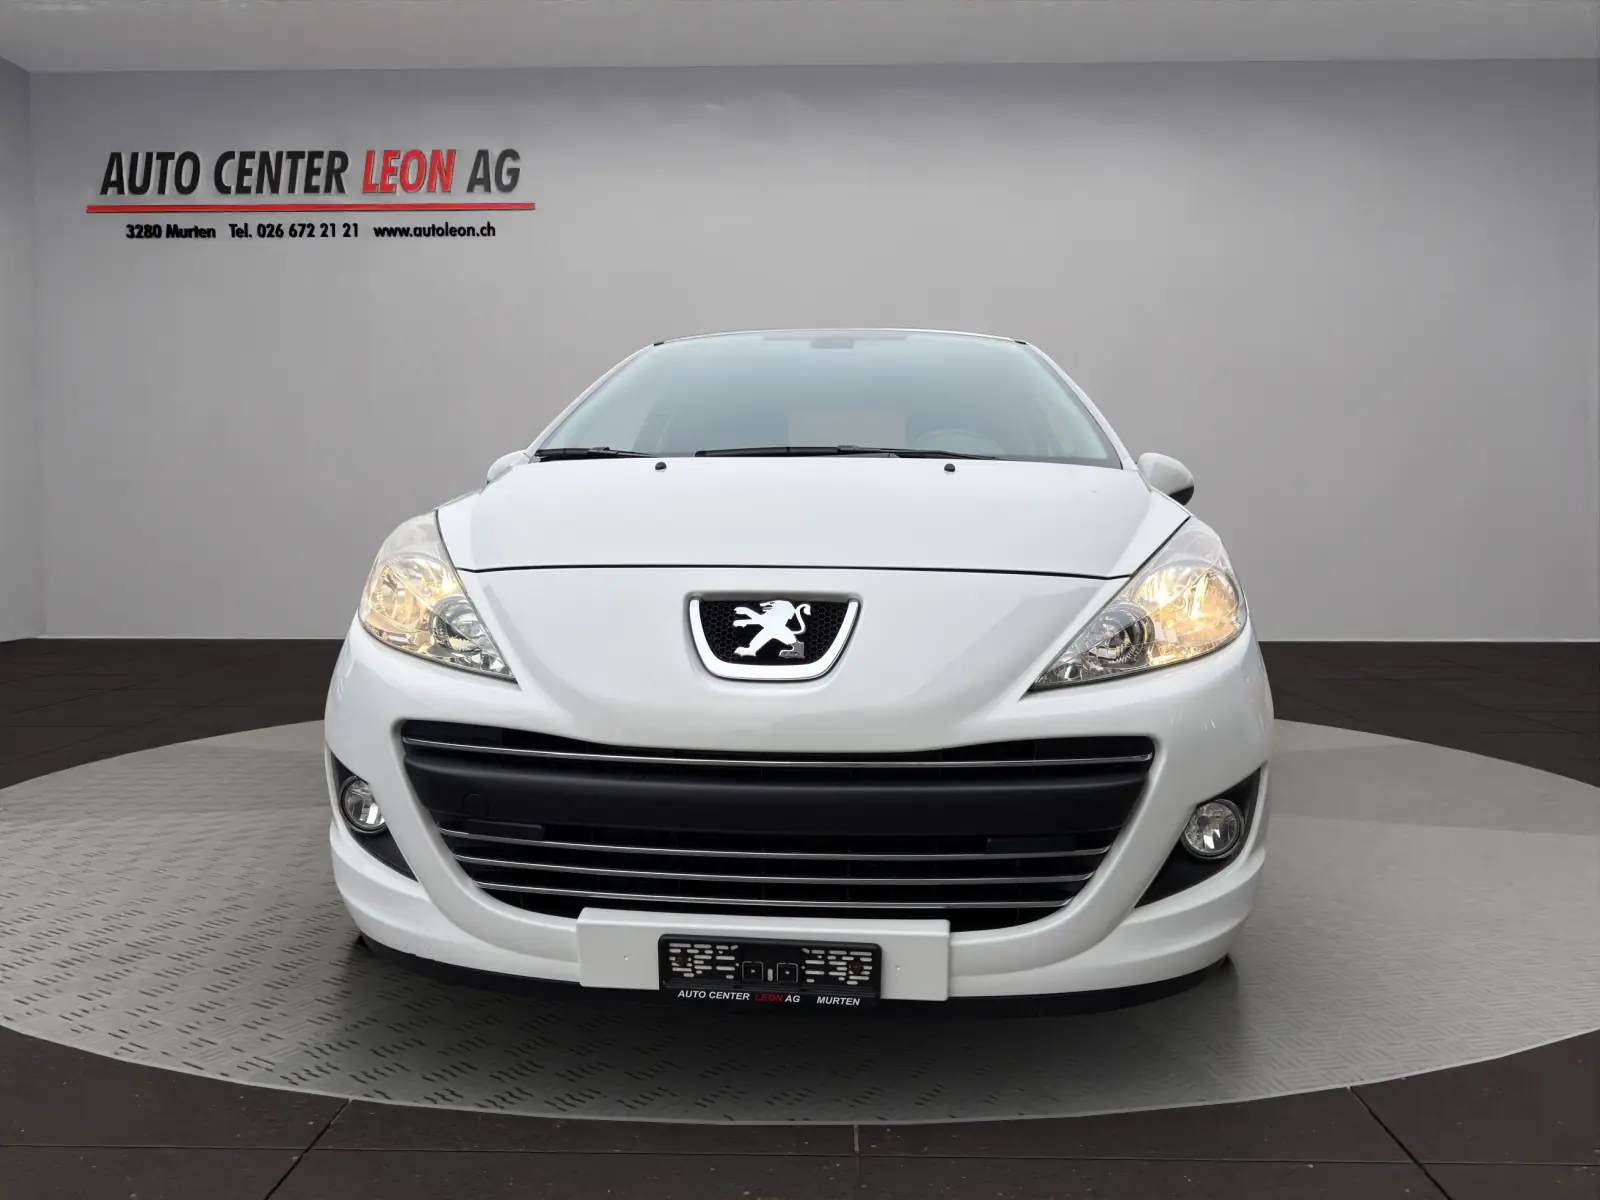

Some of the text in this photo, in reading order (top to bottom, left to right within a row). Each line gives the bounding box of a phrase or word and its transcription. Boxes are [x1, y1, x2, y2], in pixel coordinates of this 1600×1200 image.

[100, 149, 521, 195] AUTO CENTER LEON AG
[126, 222, 496, 239] 3280 Murten Tel. 026 672 21 21 www.autoleon.ch
[678, 989, 861, 1006] AUTO CENTER LEON AG MURTEN
